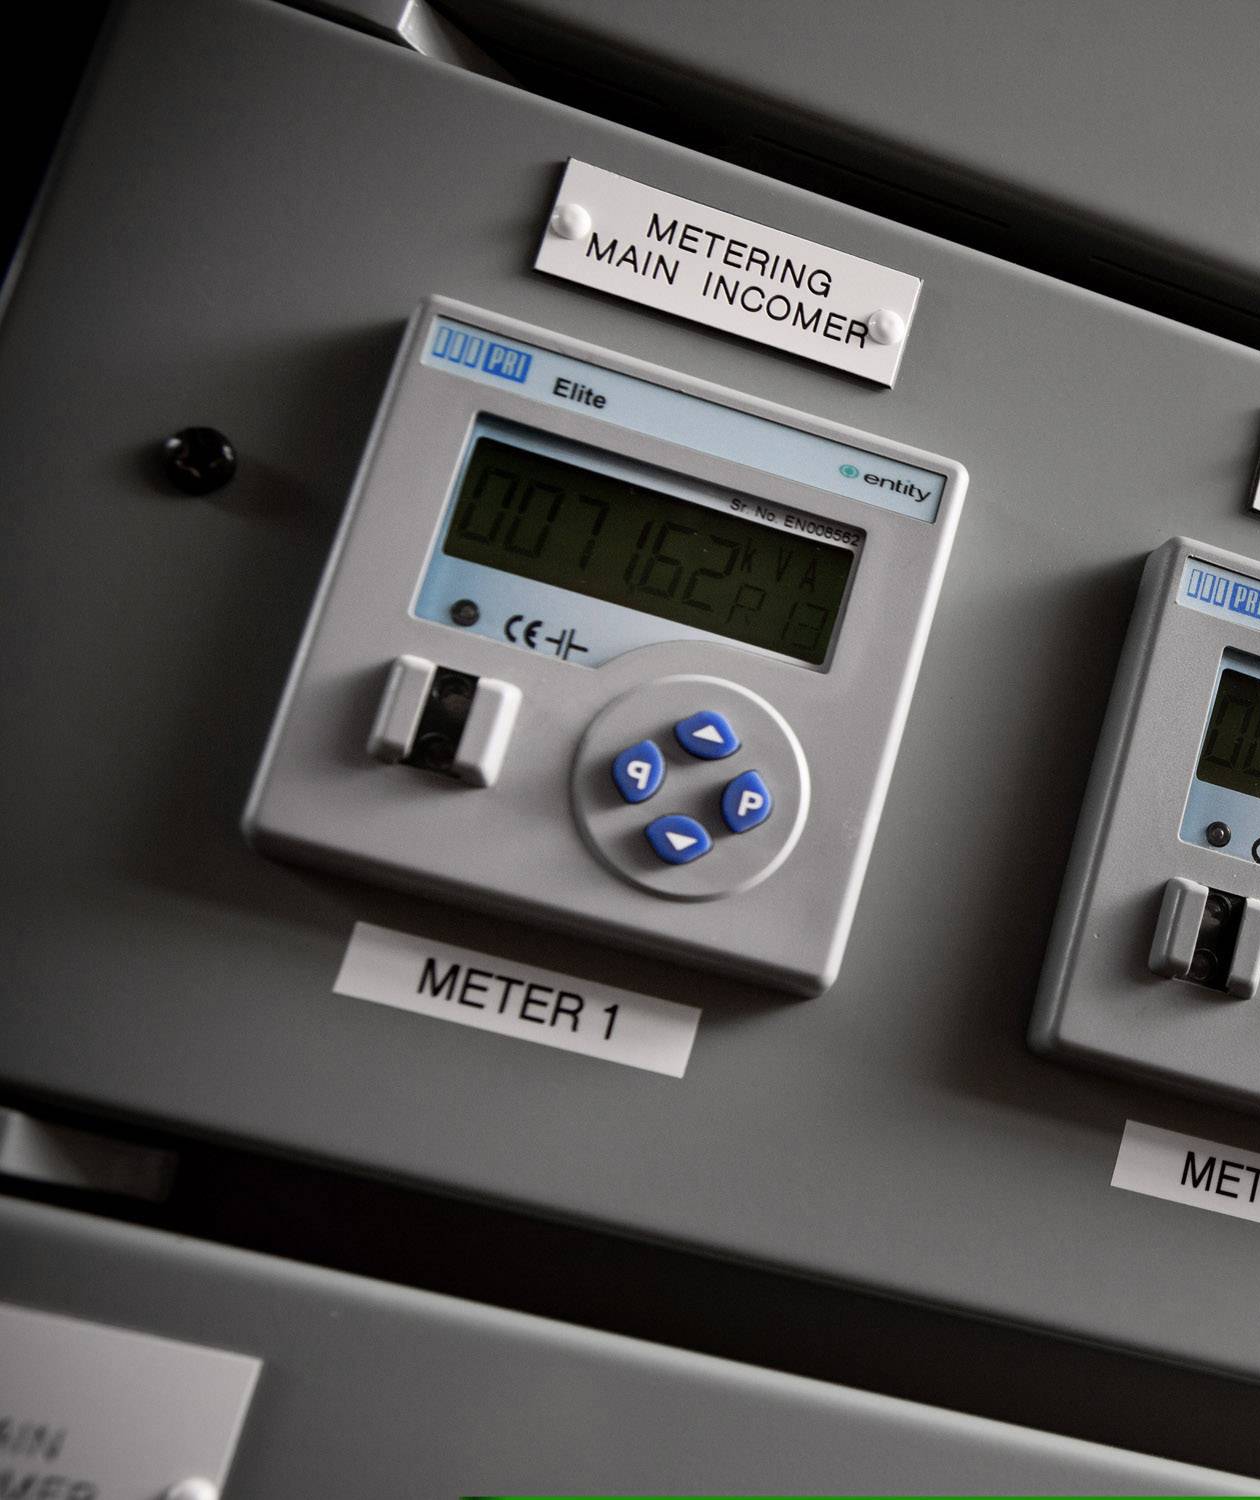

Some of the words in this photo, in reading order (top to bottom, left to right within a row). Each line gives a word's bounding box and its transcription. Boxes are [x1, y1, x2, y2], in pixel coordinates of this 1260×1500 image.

[647, 212, 833, 299] METERING
[585, 232, 681, 286] MAIN
[702, 270, 871, 350] INCOMER
[486, 342, 531, 382] PRI
[552, 376, 607, 409] Elite
[864, 473, 931, 502] entity
[755, 506, 778, 524] No.
[738, 790, 764, 818] P
[417, 957, 587, 1033] METER
[602, 1003, 621, 1041] 1
